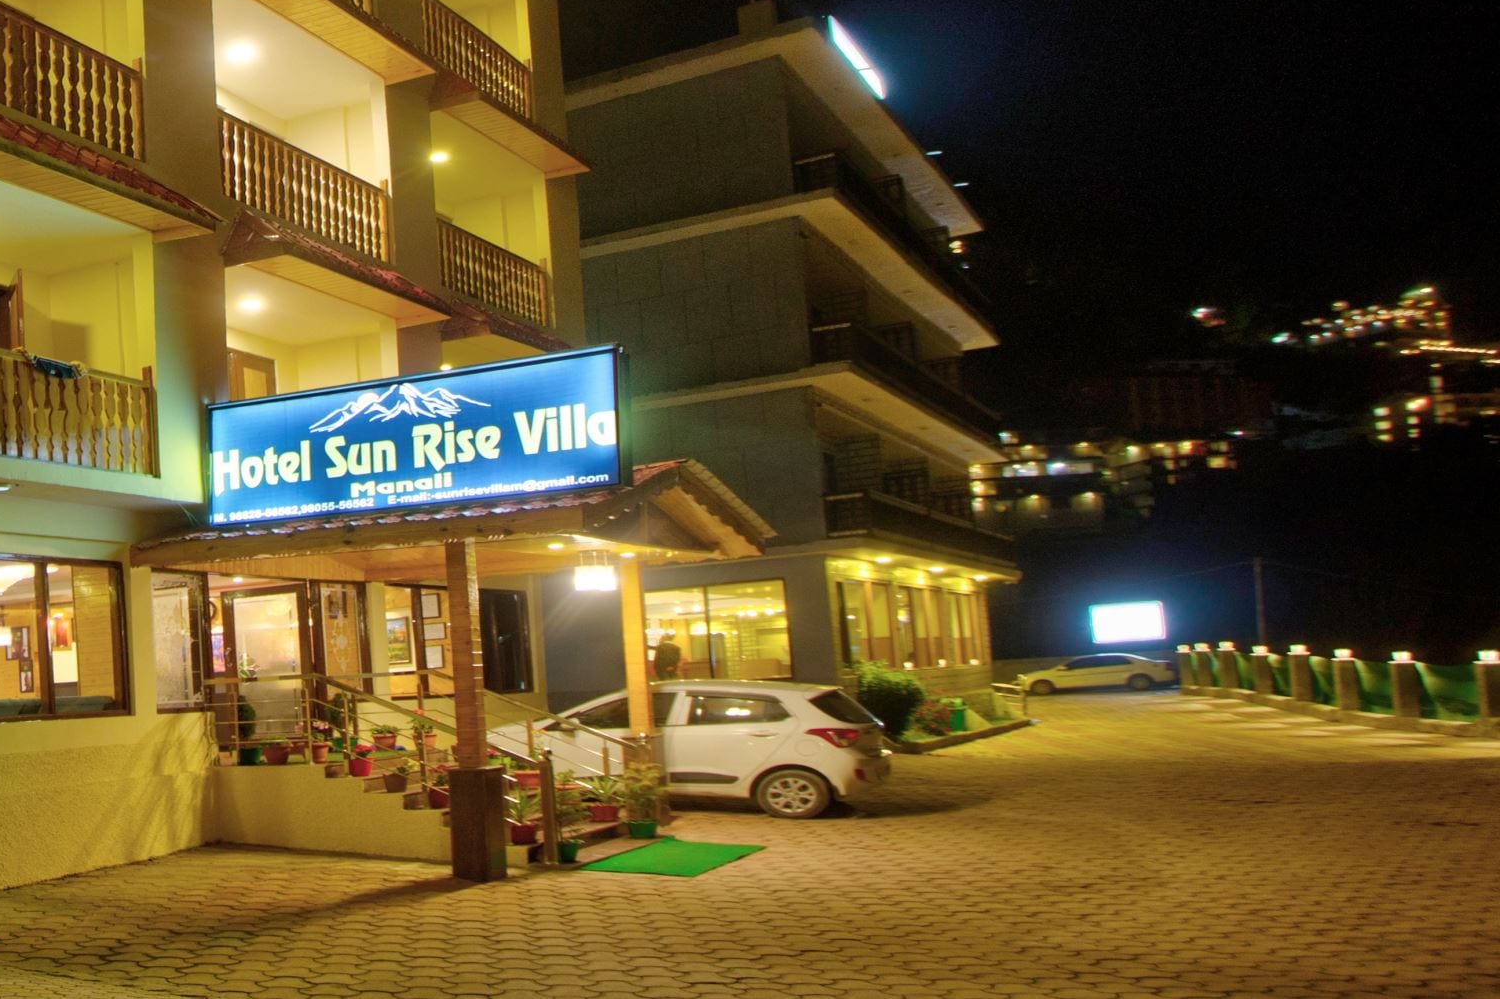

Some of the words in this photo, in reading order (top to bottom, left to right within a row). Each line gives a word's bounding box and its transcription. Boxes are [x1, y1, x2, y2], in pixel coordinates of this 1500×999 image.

[213, 440, 311, 497] Hotel
[324, 435, 397, 479] Sun
[411, 421, 501, 471] Rise
[513, 403, 617, 455] Villa
[351, 472, 453, 498] Manali
